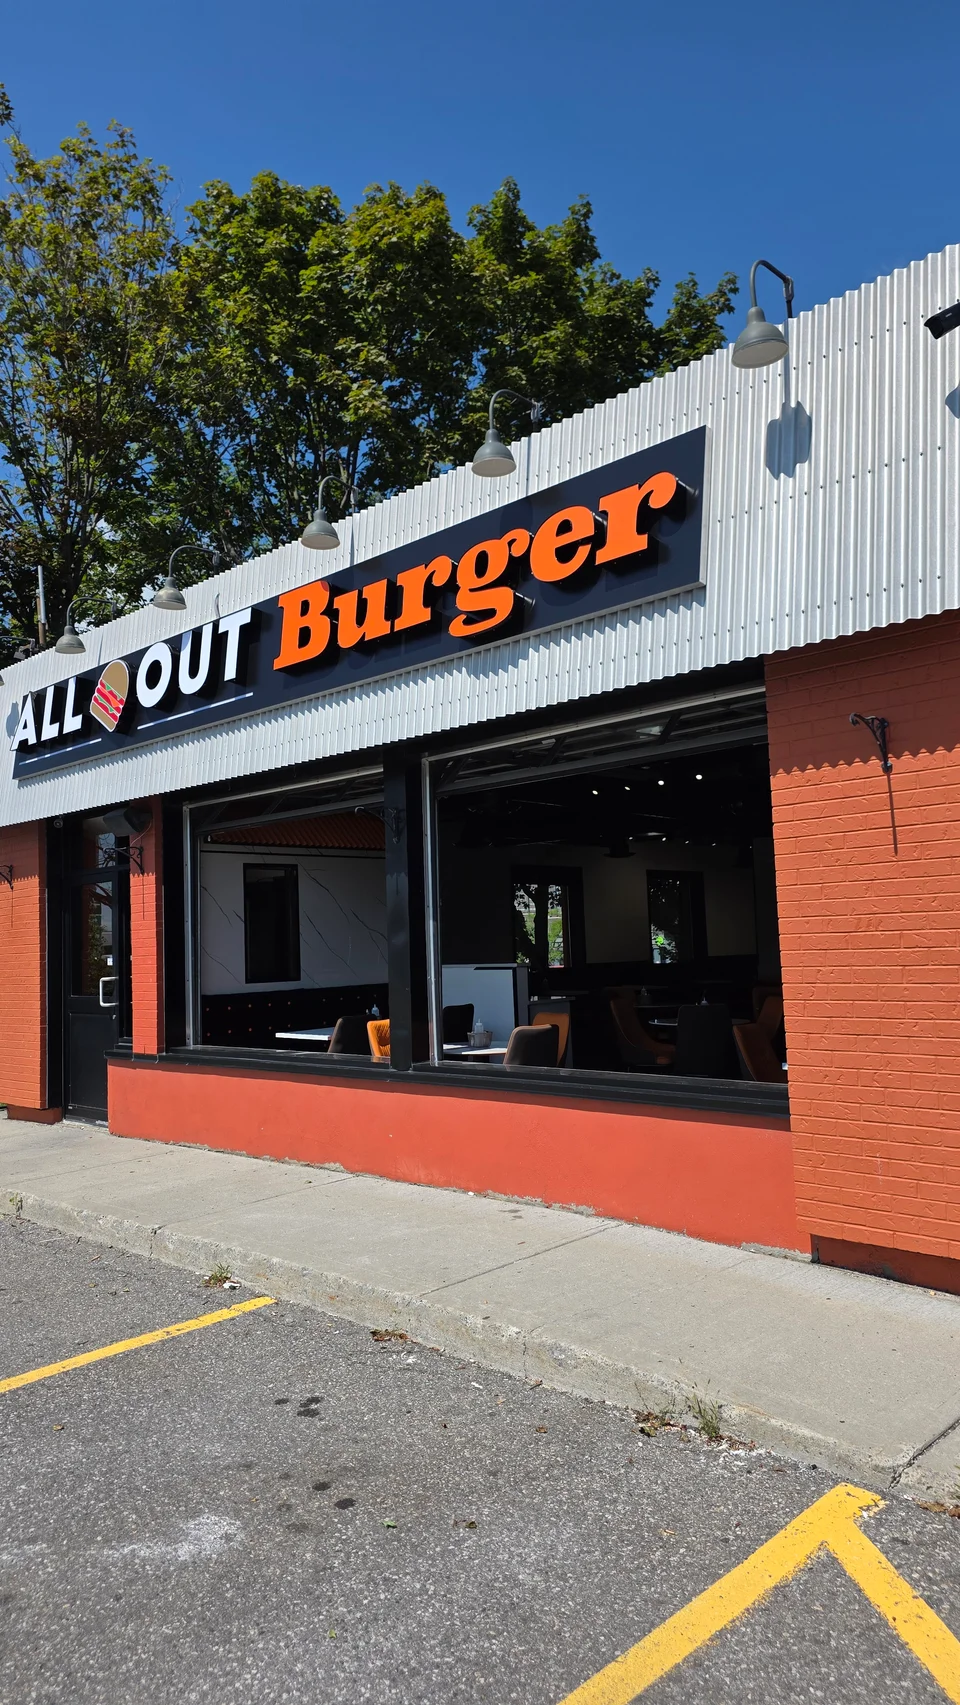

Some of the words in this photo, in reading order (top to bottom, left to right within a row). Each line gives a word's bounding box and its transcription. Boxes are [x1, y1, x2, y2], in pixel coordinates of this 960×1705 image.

[10, 676, 83, 751] ALL
[136, 606, 252, 708] OUT
[273, 471, 677, 671] Burger
